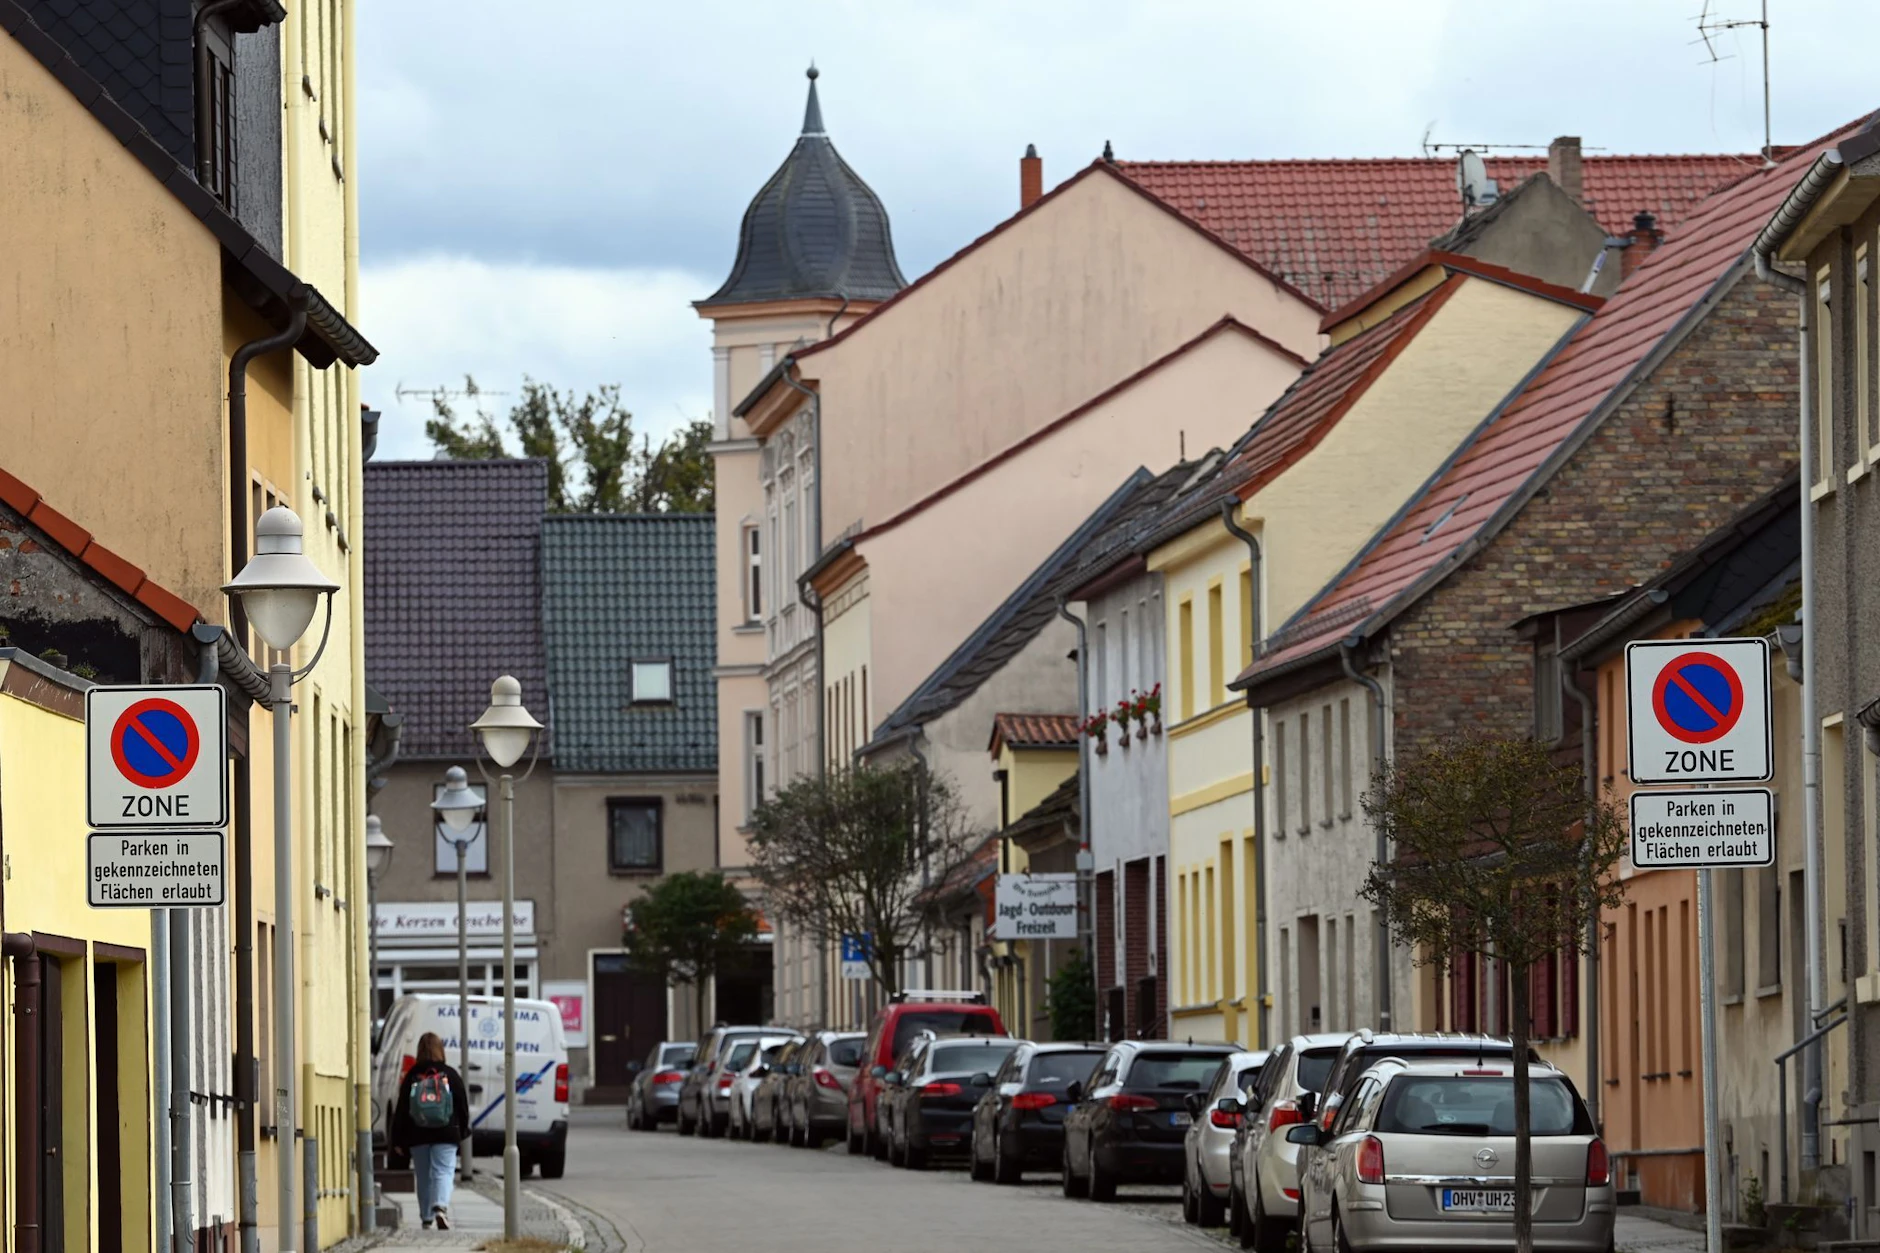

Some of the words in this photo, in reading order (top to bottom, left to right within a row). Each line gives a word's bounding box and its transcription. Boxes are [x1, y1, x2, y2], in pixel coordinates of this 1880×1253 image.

[1665, 750, 1734, 773] ZONE
[122, 795, 189, 817] ZONE
[1667, 800, 1715, 817] Parken
[1722, 800, 1735, 816] in
[1639, 821, 1764, 842] gekennzeichneten
[121, 839, 168, 856] Parken
[177, 839, 189, 855] in
[1646, 843, 1700, 859] Flächen
[1708, 841, 1757, 857] erlaubt
[95, 861, 218, 882] gekennzeichneten
[101, 884, 153, 900] Flächen
[162, 883, 212, 899] erlaubt
[999, 901, 1022, 920] Jagd
[1029, 901, 1073, 916] Outdoor
[395, 915, 446, 929] Kerzen
[1017, 919, 1056, 934] Freizeit
[498, 1010, 540, 1021] KIMA
[1453, 1192, 1476, 1206] OHV
